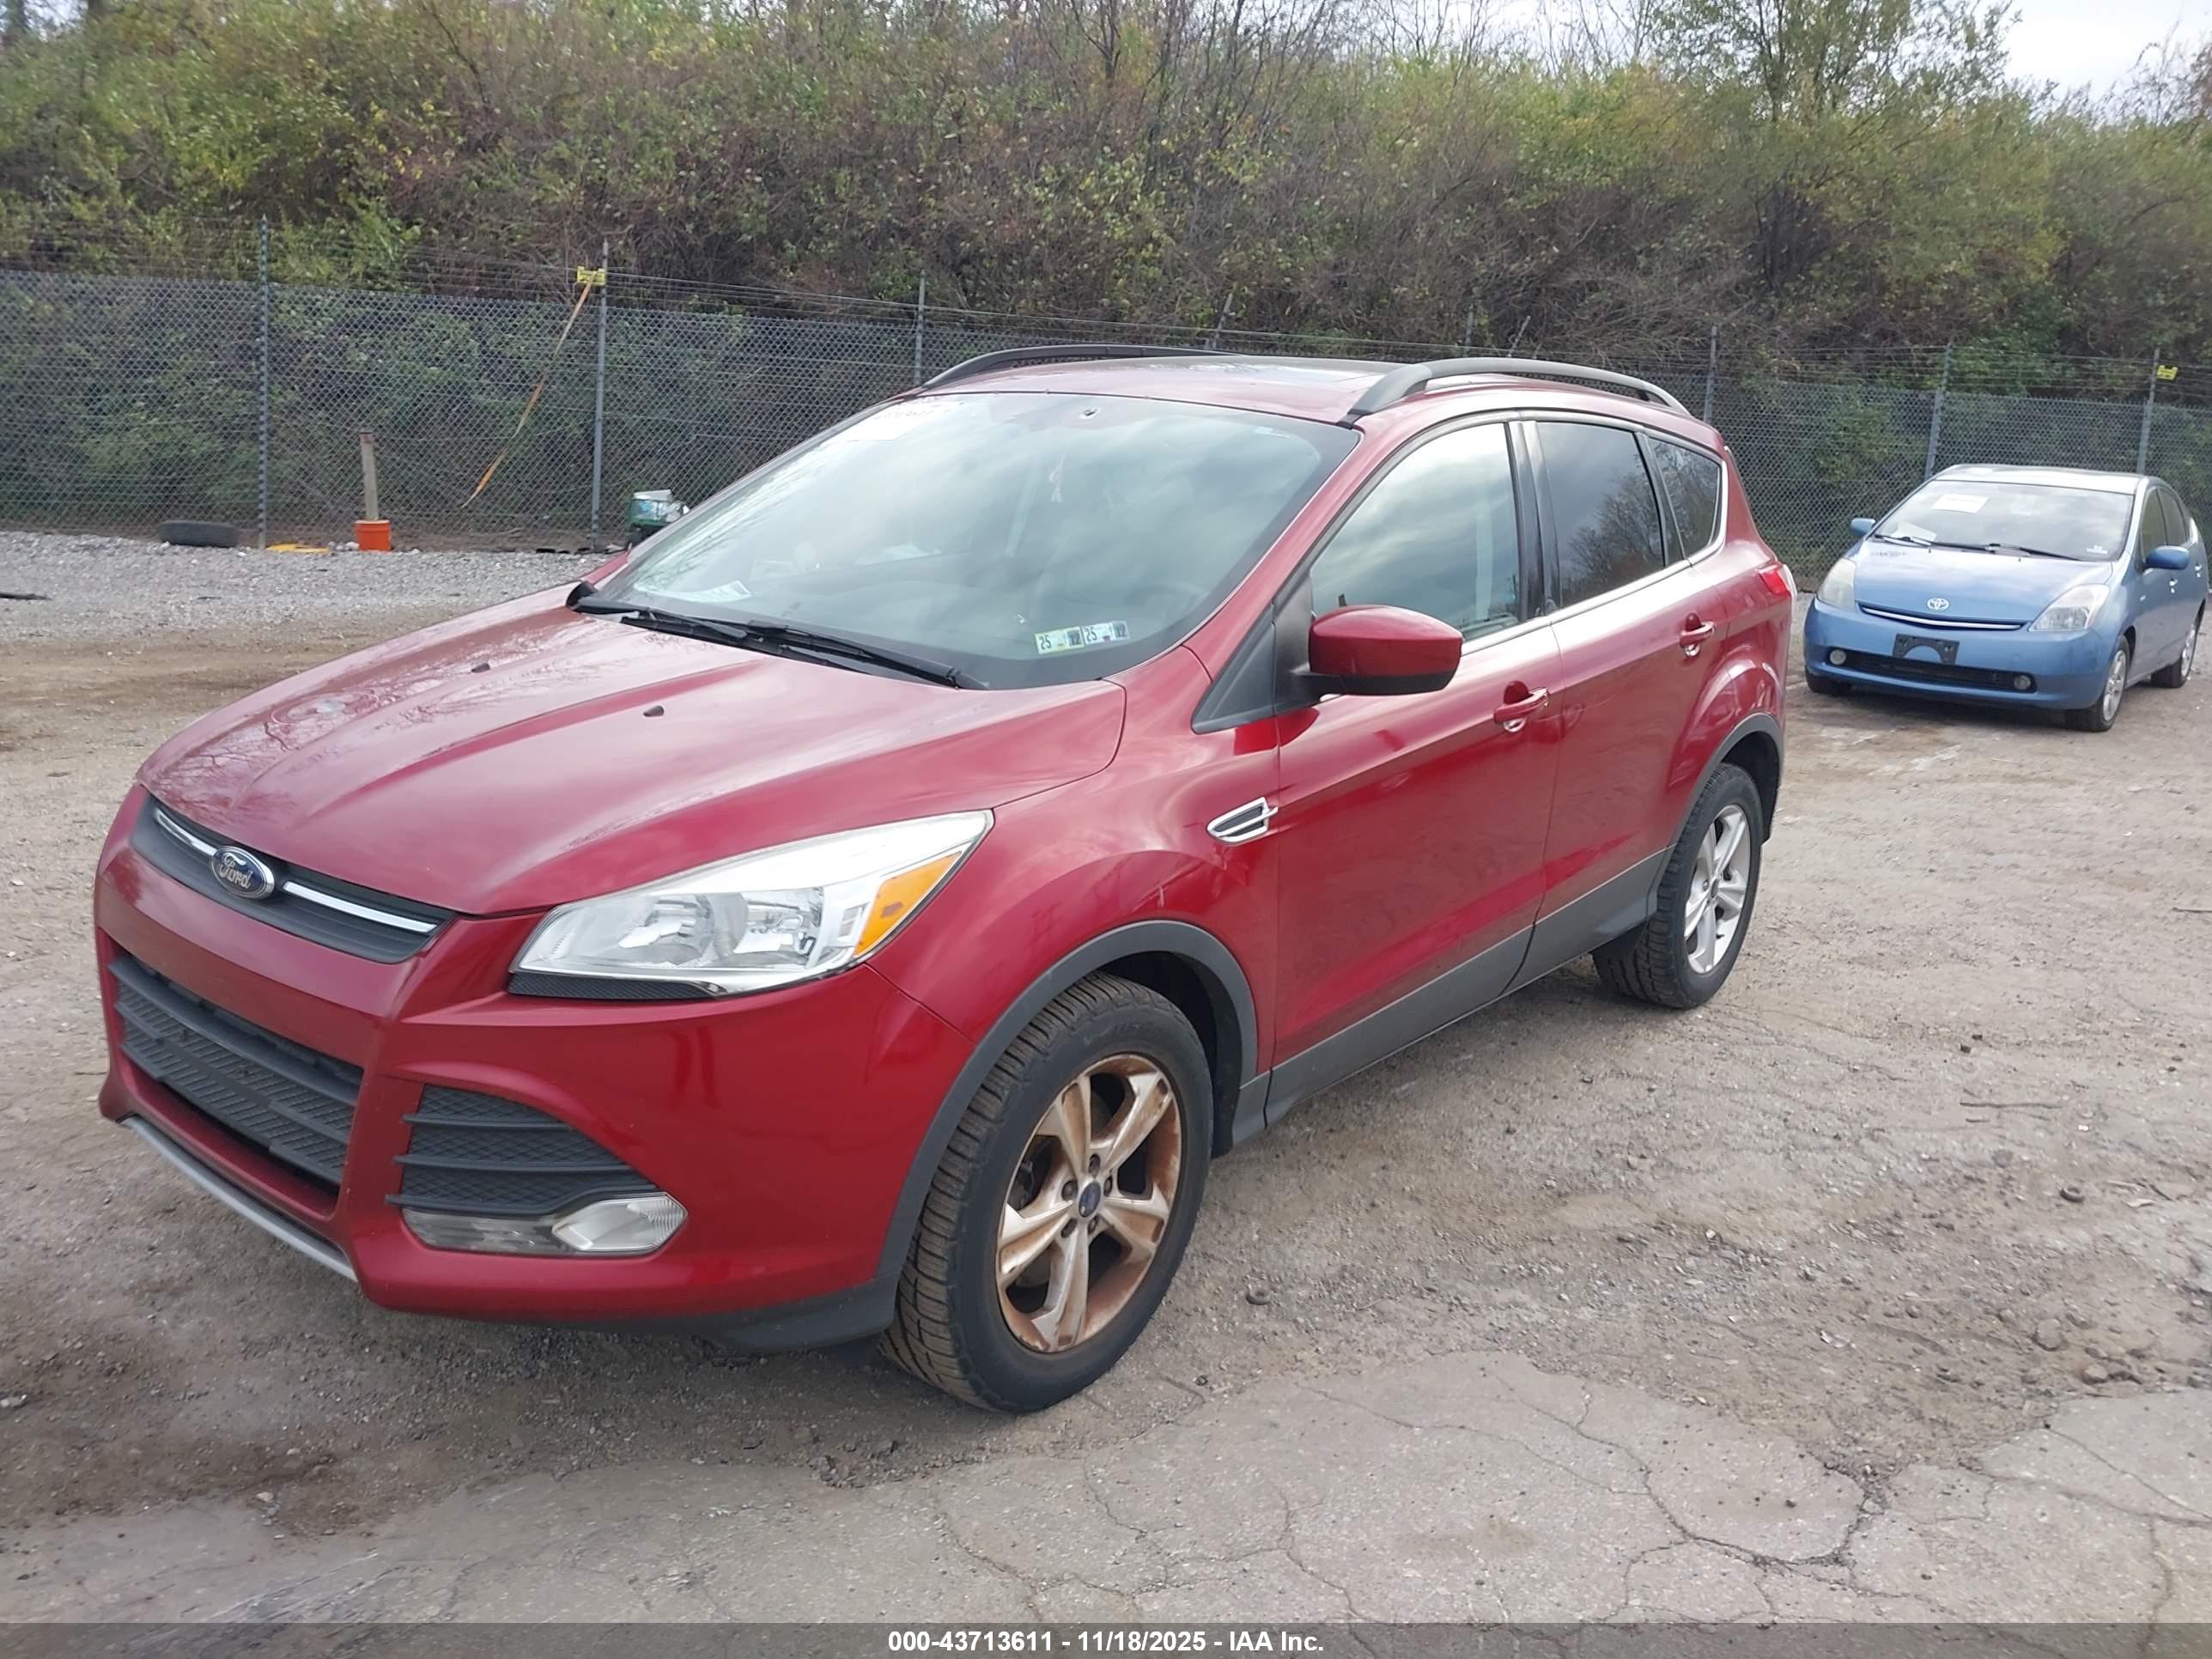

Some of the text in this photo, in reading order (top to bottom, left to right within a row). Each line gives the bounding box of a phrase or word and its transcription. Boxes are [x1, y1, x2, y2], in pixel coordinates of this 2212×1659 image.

[1085, 627, 1097, 641] 25
[1038, 635, 1052, 650] 25
[218, 852, 254, 890] Ford
